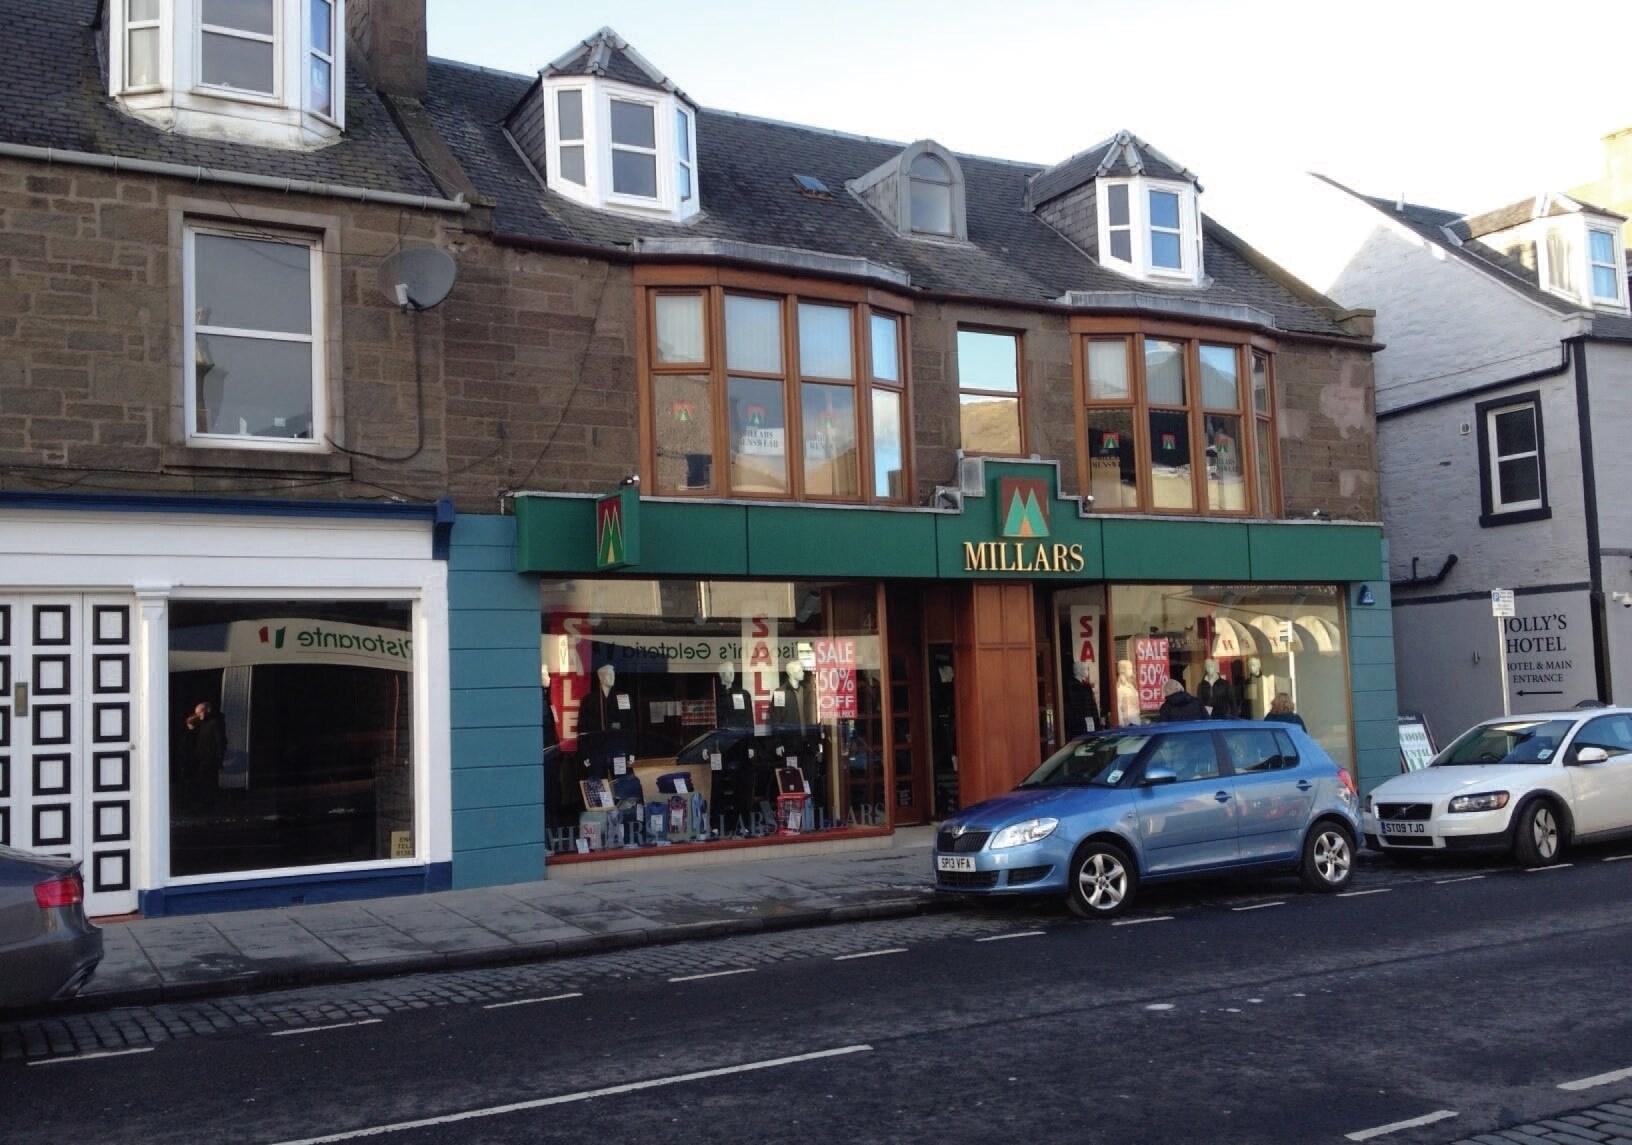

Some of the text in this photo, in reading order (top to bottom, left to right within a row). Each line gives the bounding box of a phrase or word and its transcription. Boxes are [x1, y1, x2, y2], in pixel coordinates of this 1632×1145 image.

[963, 541, 1085, 572] MILLARS
[1504, 614, 1567, 635] JOLLY'S
[817, 642, 853, 663] SALE
[1079, 616, 1095, 685] SA
[1137, 641, 1167, 660] SALE
[1506, 637, 1566, 653] HOTEL
[750, 614, 772, 725] SALE
[1139, 664, 1168, 685] 50%
[1536, 662, 1544, 670] &
[1546, 660, 1572, 670] MAIN
[819, 667, 855, 691] 50%
[1513, 674, 1564, 683] ENTRANCE
[820, 695, 854, 709] OFF
[1386, 823, 1406, 833] ST09
[956, 858, 970, 869] VFA
